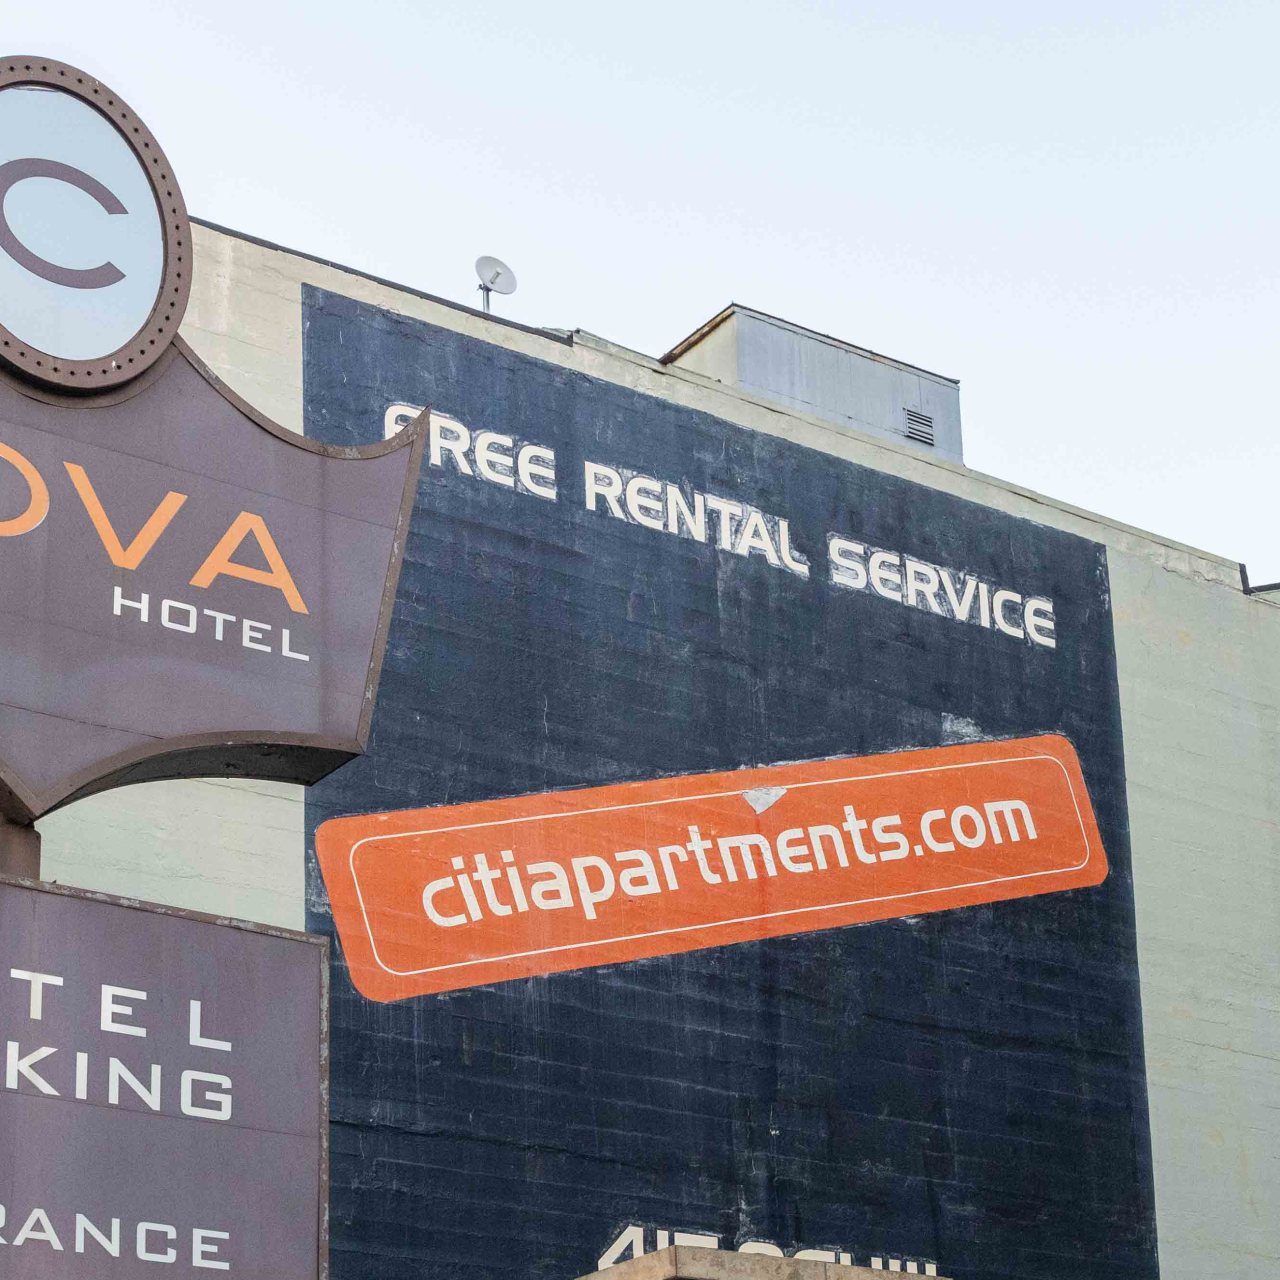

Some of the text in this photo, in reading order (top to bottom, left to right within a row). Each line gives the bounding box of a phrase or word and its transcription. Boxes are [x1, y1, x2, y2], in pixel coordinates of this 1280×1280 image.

[384, 402, 1057, 649] FREE RENTAL SERVICE
[113, 586, 311, 661] HOTEL
[420, 797, 1039, 928] citiapartments.com
